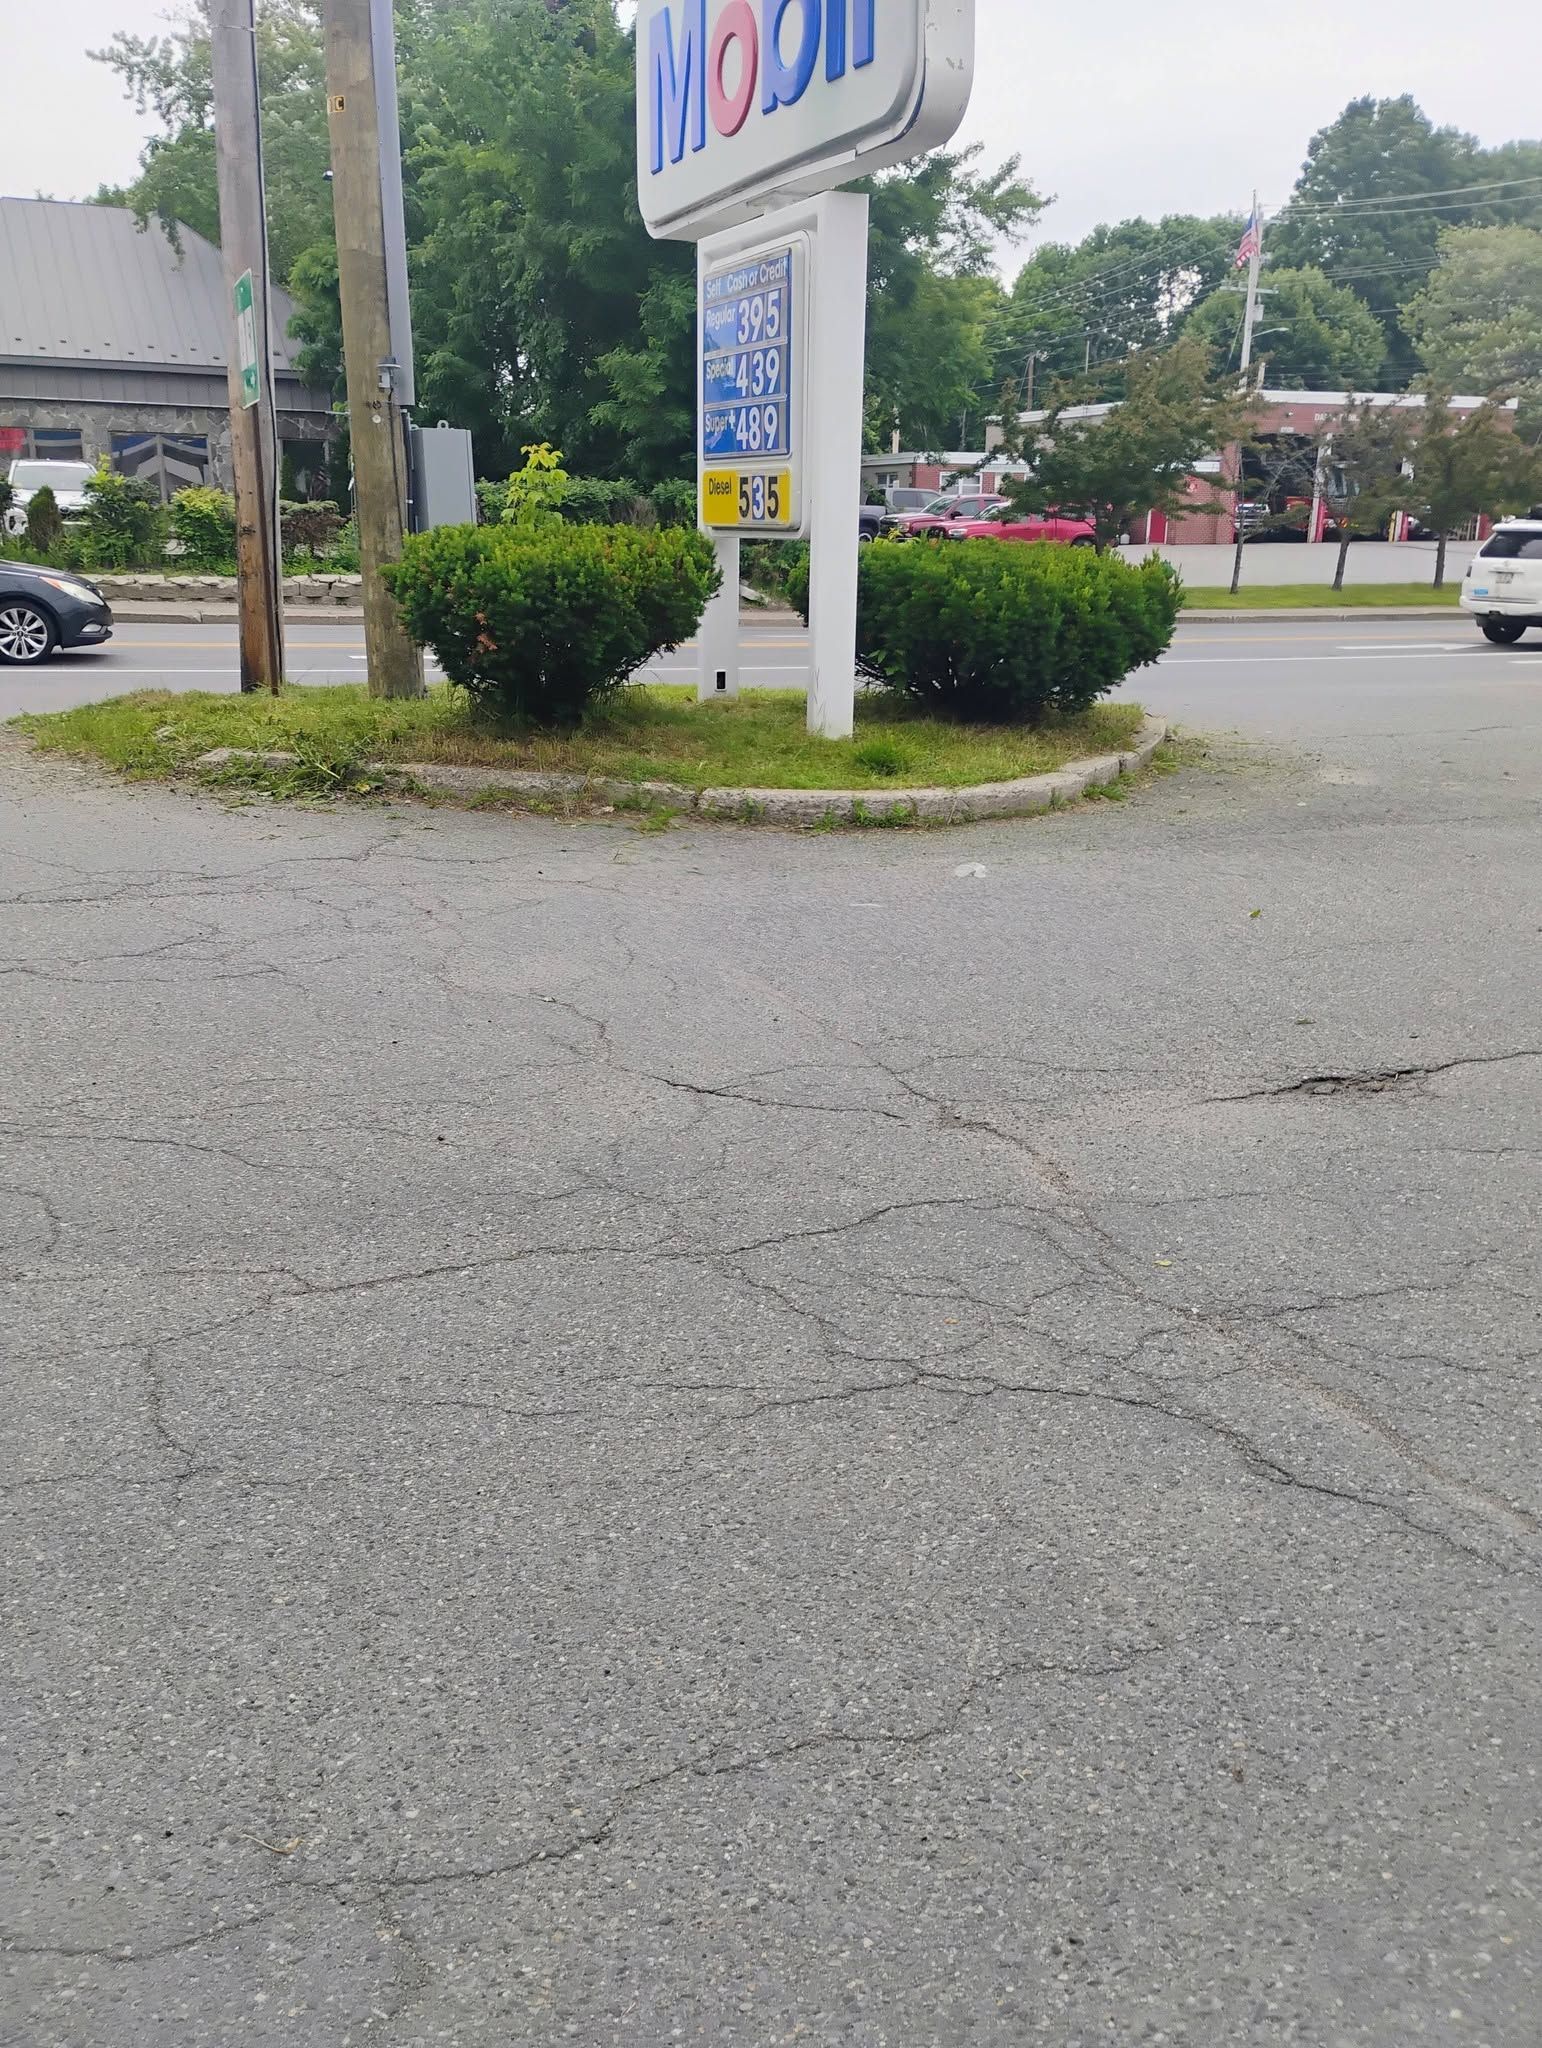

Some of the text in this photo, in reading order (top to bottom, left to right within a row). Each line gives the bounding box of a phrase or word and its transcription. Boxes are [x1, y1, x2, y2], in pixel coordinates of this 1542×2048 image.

[706, 257, 786, 299] Self Cash or Credit
[706, 290, 780, 344] Regular 395
[706, 348, 780, 397] Special 439
[736, 405, 778, 450] 489
[708, 476, 779, 519] Diesel 535
